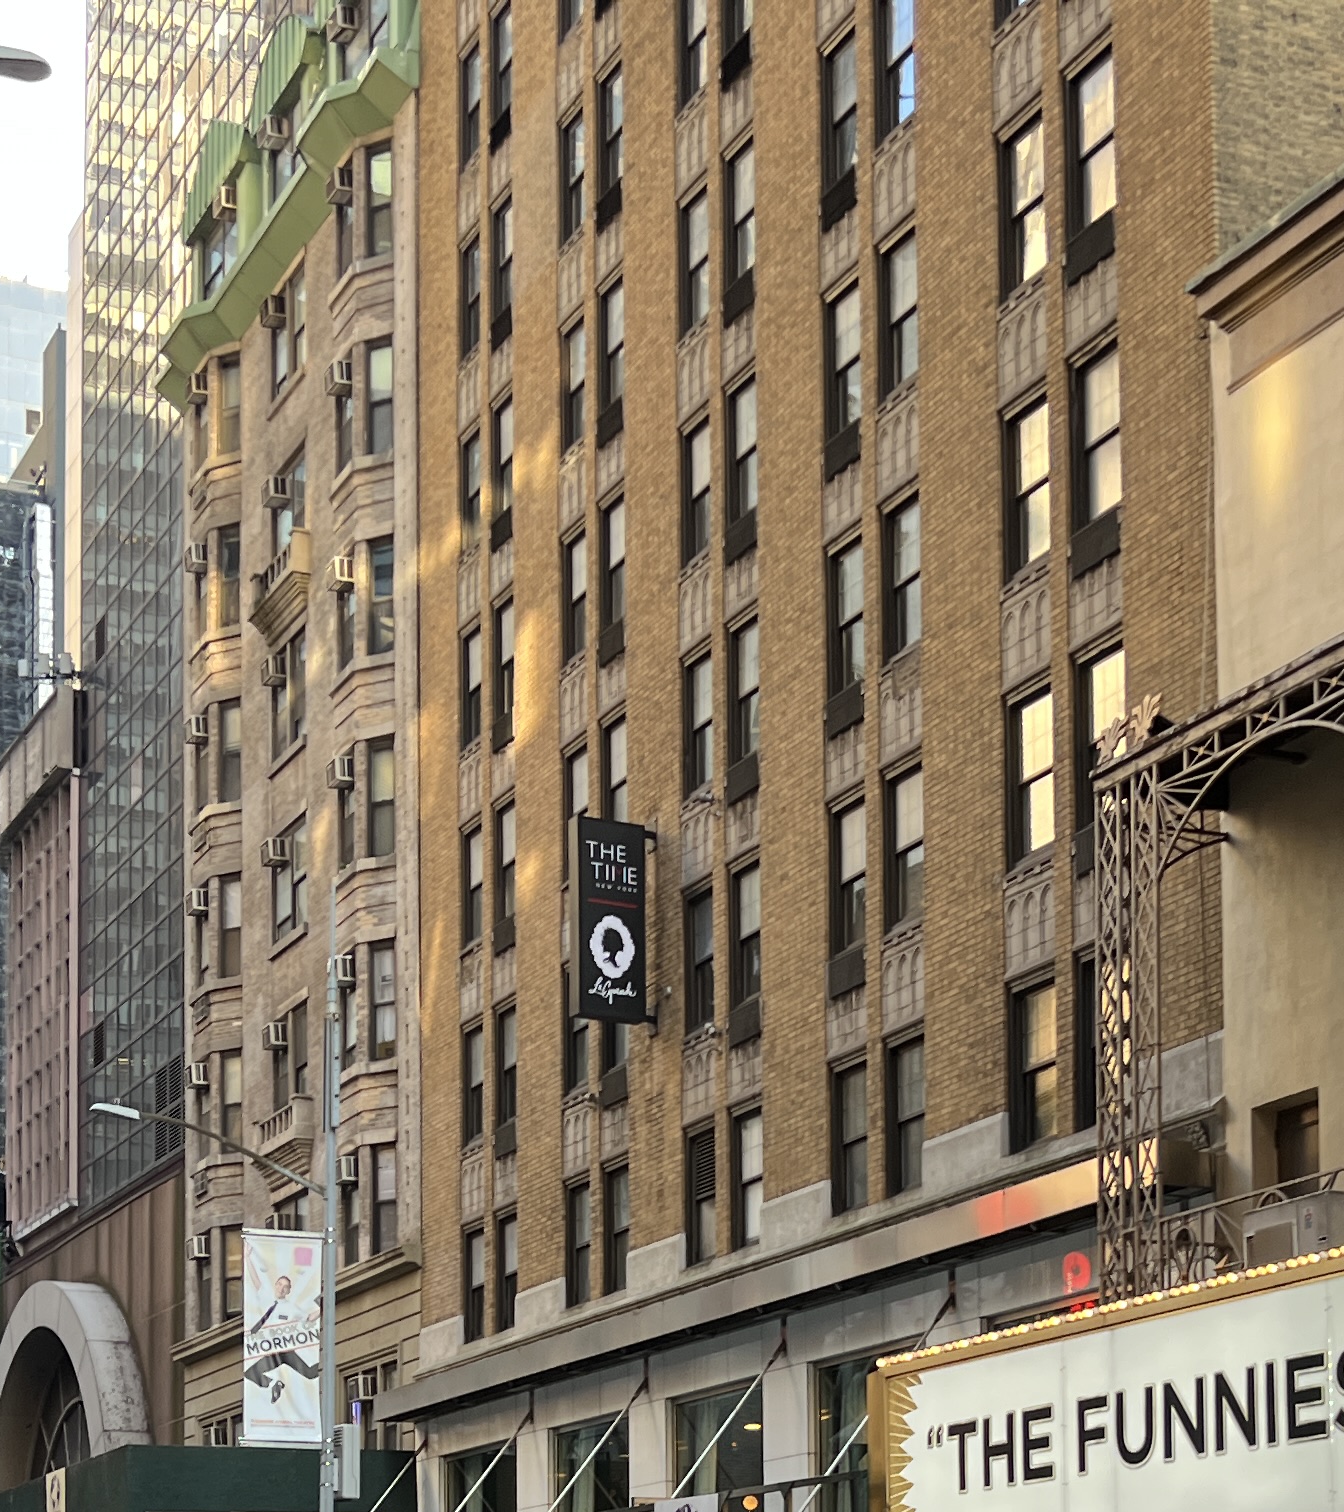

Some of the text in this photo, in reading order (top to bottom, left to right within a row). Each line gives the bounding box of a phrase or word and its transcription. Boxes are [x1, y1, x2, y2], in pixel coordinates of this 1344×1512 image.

[585, 839, 627, 864] THE
[590, 861, 638, 886] TIME
[246, 1328, 320, 1356] MORMON
